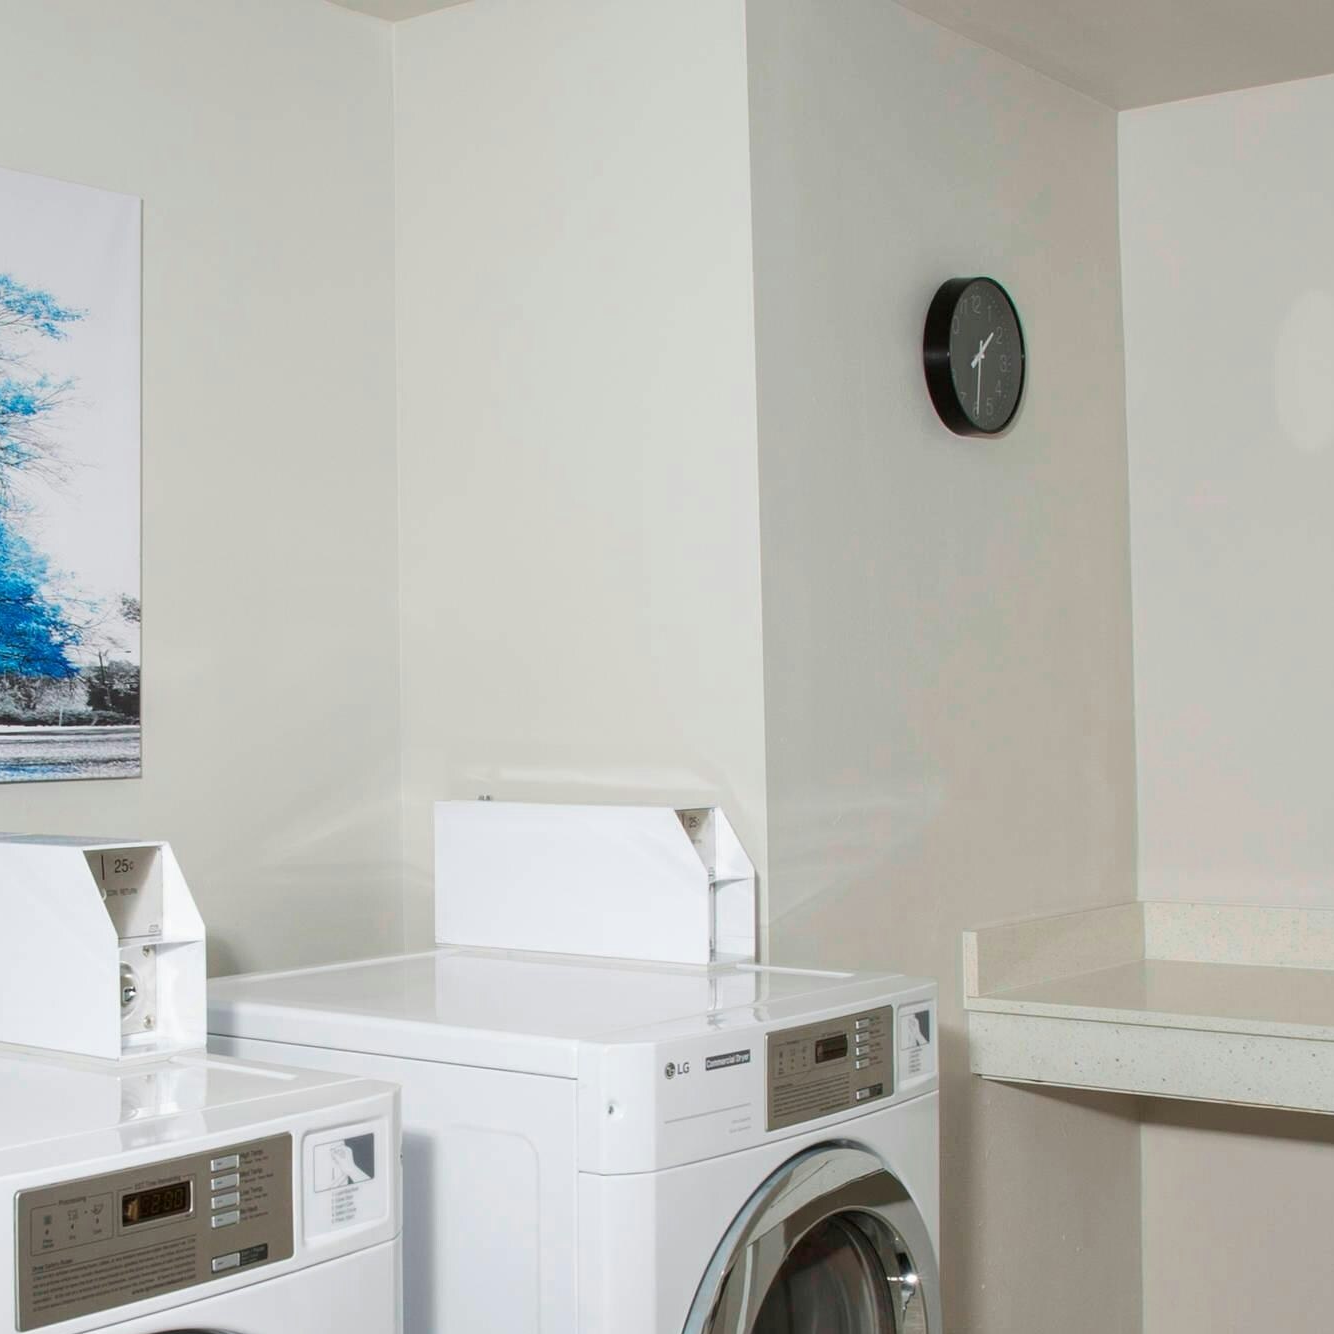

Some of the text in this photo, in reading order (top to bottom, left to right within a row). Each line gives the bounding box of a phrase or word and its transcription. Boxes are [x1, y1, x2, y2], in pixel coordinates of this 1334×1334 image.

[995, 326, 1003, 345] 2
[986, 397, 994, 416] 5
[114, 858, 134, 874] 25¢
[677, 1061, 690, 1075] LG
